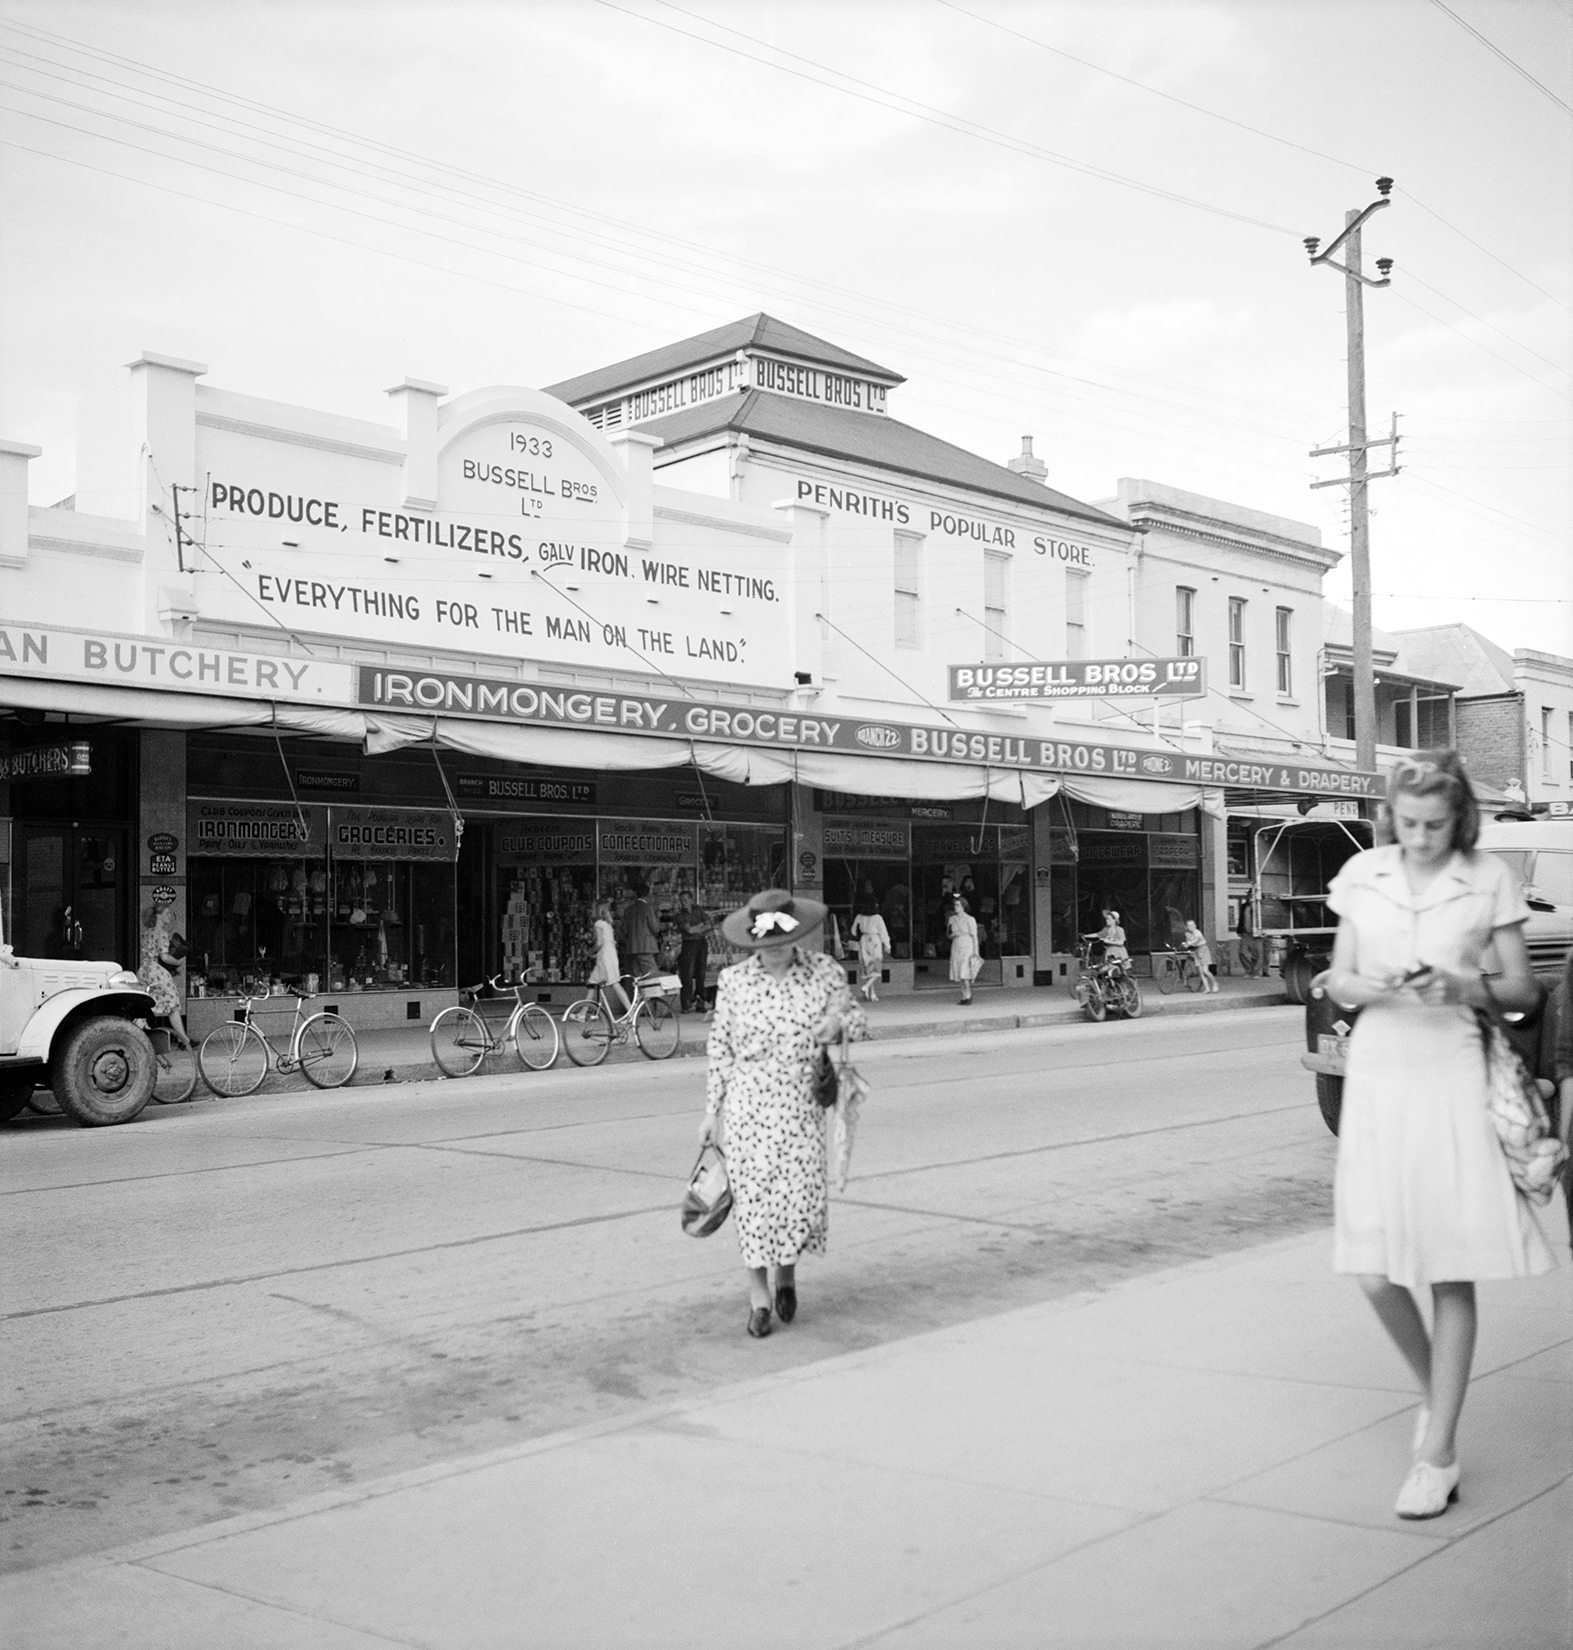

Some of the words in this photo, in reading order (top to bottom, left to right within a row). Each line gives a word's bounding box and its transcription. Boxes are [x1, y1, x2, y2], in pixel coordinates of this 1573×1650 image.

[634, 379, 687, 421] BUSSELL
[690, 366, 724, 403] BROS
[756, 359, 821, 399] BUSSELL
[825, 374, 861, 408] BROS
[867, 383, 886, 413] LTD
[510, 431, 553, 458] 1933
[463, 459, 556, 496] BUSSELL
[522, 497, 543, 518] LTD
[797, 479, 910, 525] PENRITH'S
[930, 511, 1016, 549] POPULAR
[1033, 536, 1096, 568] STORE.
[212, 482, 348, 533] PRODUCE,
[362, 508, 530, 563] FERTILIZERS,
[538, 542, 575, 568] GALV
[642, 559, 690, 588] WIRE
[698, 568, 779, 602] NETTING.
[436, 600, 479, 629] FOR
[491, 607, 533, 636] THE
[545, 616, 591, 643] MAN
[603, 623, 627, 648] ON
[637, 628, 675, 654] THE
[83, 639, 323, 694] BUTCHERY.
[957, 665, 1077, 688] BUSSELL
[1084, 662, 1157, 685] BROS
[1166, 661, 1199, 682] LTD
[967, 686, 984, 699] The
[985, 685, 1040, 698] CENTRE
[1043, 684, 1107, 696] SHOPPING
[1108, 682, 1151, 695] BLOCK
[373, 671, 679, 733] IRONMONGERY,
[685, 706, 842, 747] GROCERY
[857, 727, 884, 747] BRANCH
[911, 728, 1032, 764] BUSSELL
[1039, 741, 1106, 769] BROS
[1112, 749, 1138, 773] LTD
[459, 778, 483, 786] BRANCH
[489, 780, 538, 798] BUSSELL
[572, 785, 590, 800] LTD
[1185, 759, 1274, 785] MERCERY
[1280, 770, 1291, 786] &
[1299, 770, 1376, 795] DRAPERY.
[338, 824, 446, 846] GROCERIES.
[502, 836, 535, 852] CLUB
[537, 834, 594, 851] COUPONS
[601, 833, 692, 852] CONFECTIONARY
[155, 855, 172, 863] ETA
